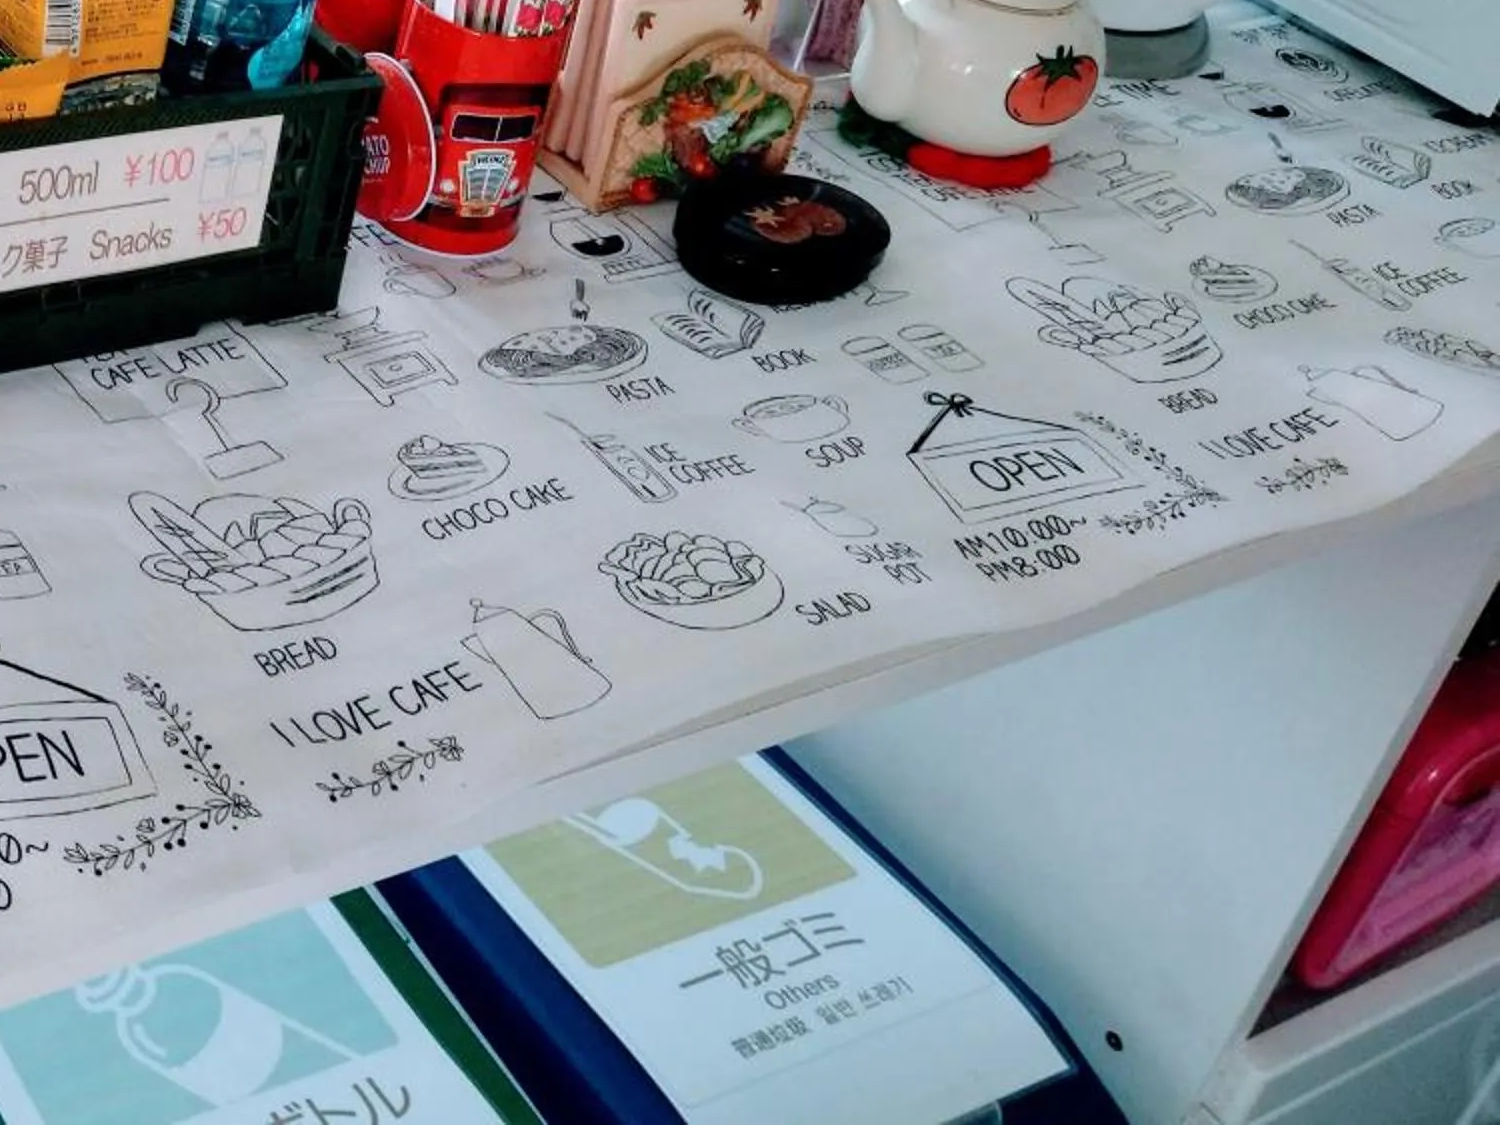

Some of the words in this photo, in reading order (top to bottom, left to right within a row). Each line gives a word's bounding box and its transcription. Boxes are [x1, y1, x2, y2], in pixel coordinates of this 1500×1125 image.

[1110, 78, 1181, 100] TIME
[19, 160, 102, 205] 500ml
[124, 147, 195, 187] ¥100
[1325, 203, 1380, 227] PASTA
[90, 223, 173, 261] Snacks
[197, 206, 247, 243] ¥50
[1397, 266, 1469, 297] COFFEE
[91, 357, 162, 391] CAFE
[157, 338, 247, 374] LATTE
[752, 347, 817, 374] BOOK
[605, 377, 675, 405] PASTA
[1158, 388, 1219, 414] BREAD
[1210, 426, 1284, 459] LOVE
[1269, 407, 1339, 444] CAFE
[644, 442, 688, 465] ICE
[669, 454, 756, 485] COFFEE
[805, 435, 865, 469] SOUP
[969, 448, 1086, 492] OPEN
[422, 498, 509, 540] CHOCO
[509, 478, 575, 511] CAKE
[883, 562, 933, 585] POT
[795, 591, 872, 627] SALAD
[253, 635, 338, 678] BREAD
[269, 721, 296, 748] I
[290, 695, 392, 744] LOVE
[388, 660, 483, 716] CAFE
[679, 911, 865, 991] 一般ゴミ
[763, 973, 841, 1010] Others
